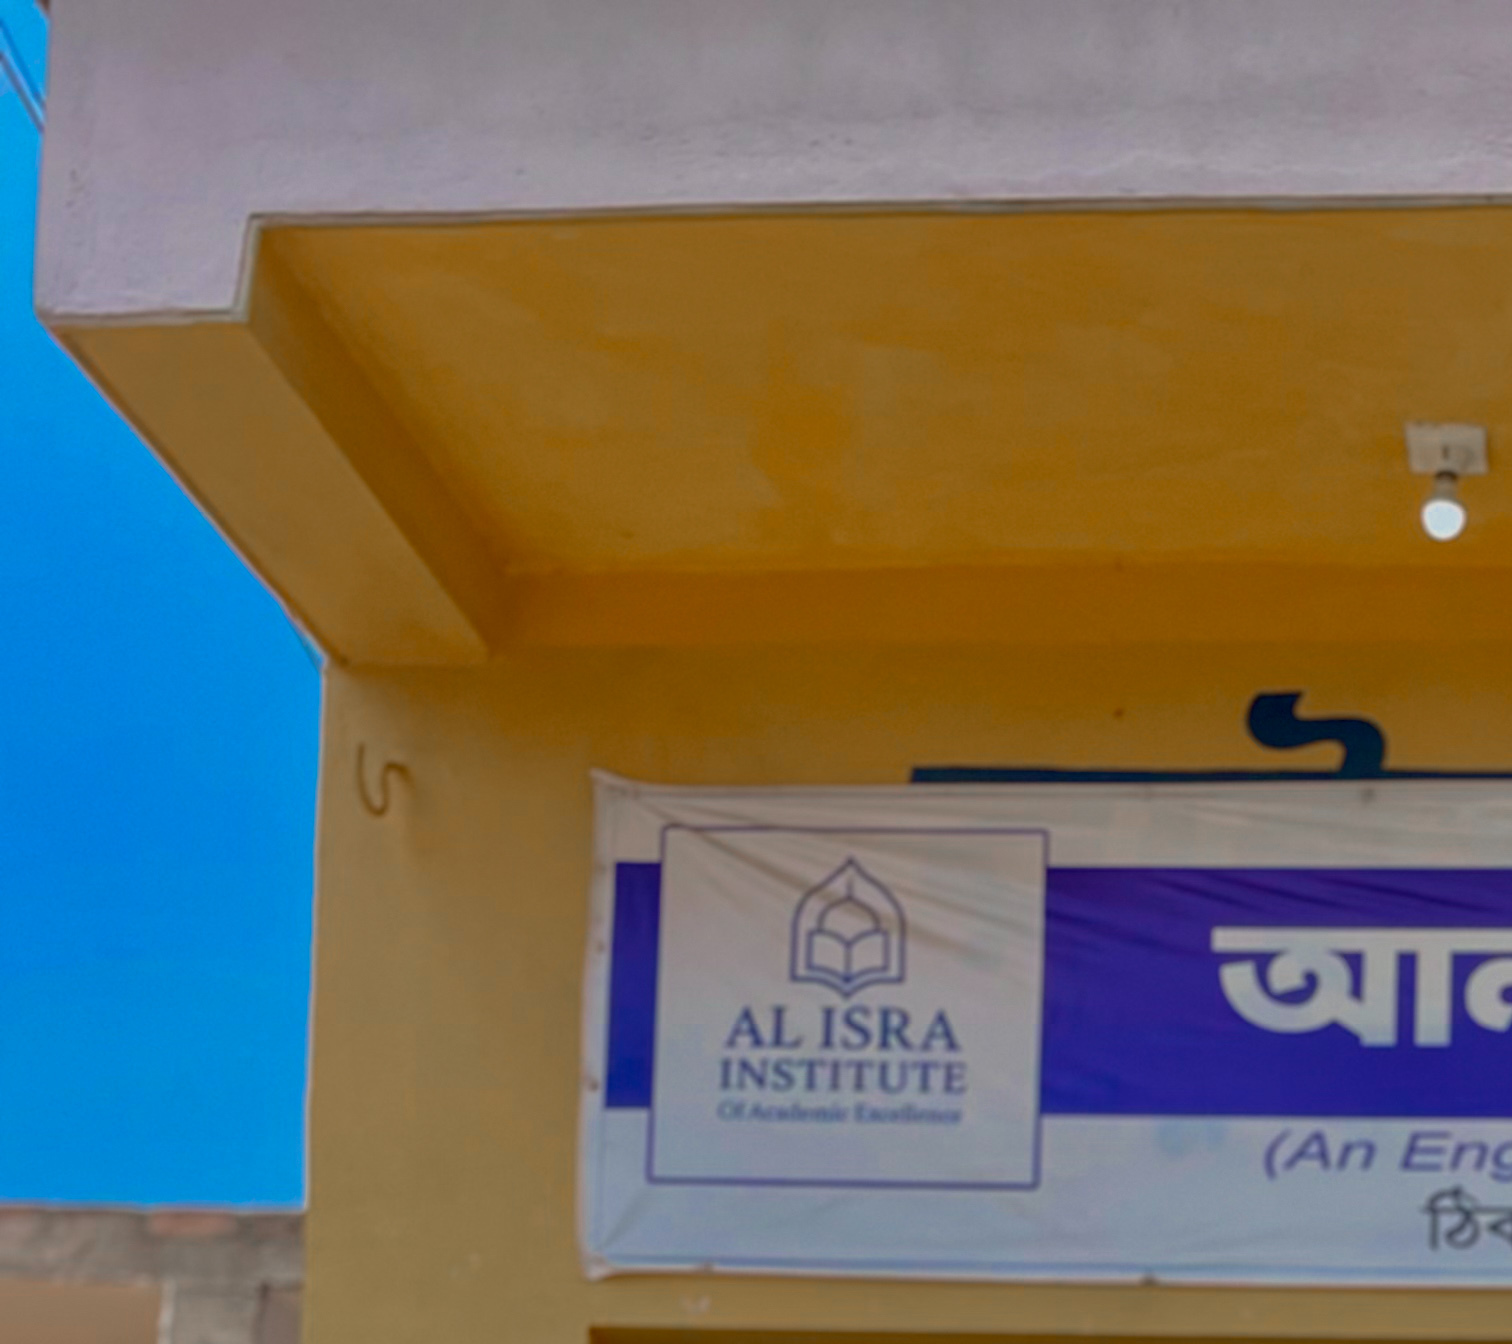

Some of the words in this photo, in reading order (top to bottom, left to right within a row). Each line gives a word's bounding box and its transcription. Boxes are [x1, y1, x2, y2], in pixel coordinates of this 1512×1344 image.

[726, 1005, 804, 1049] AL
[820, 1004, 963, 1051] ISRA
[719, 1057, 968, 1094] INSTITUTE
[1262, 1130, 1378, 1181] (An
